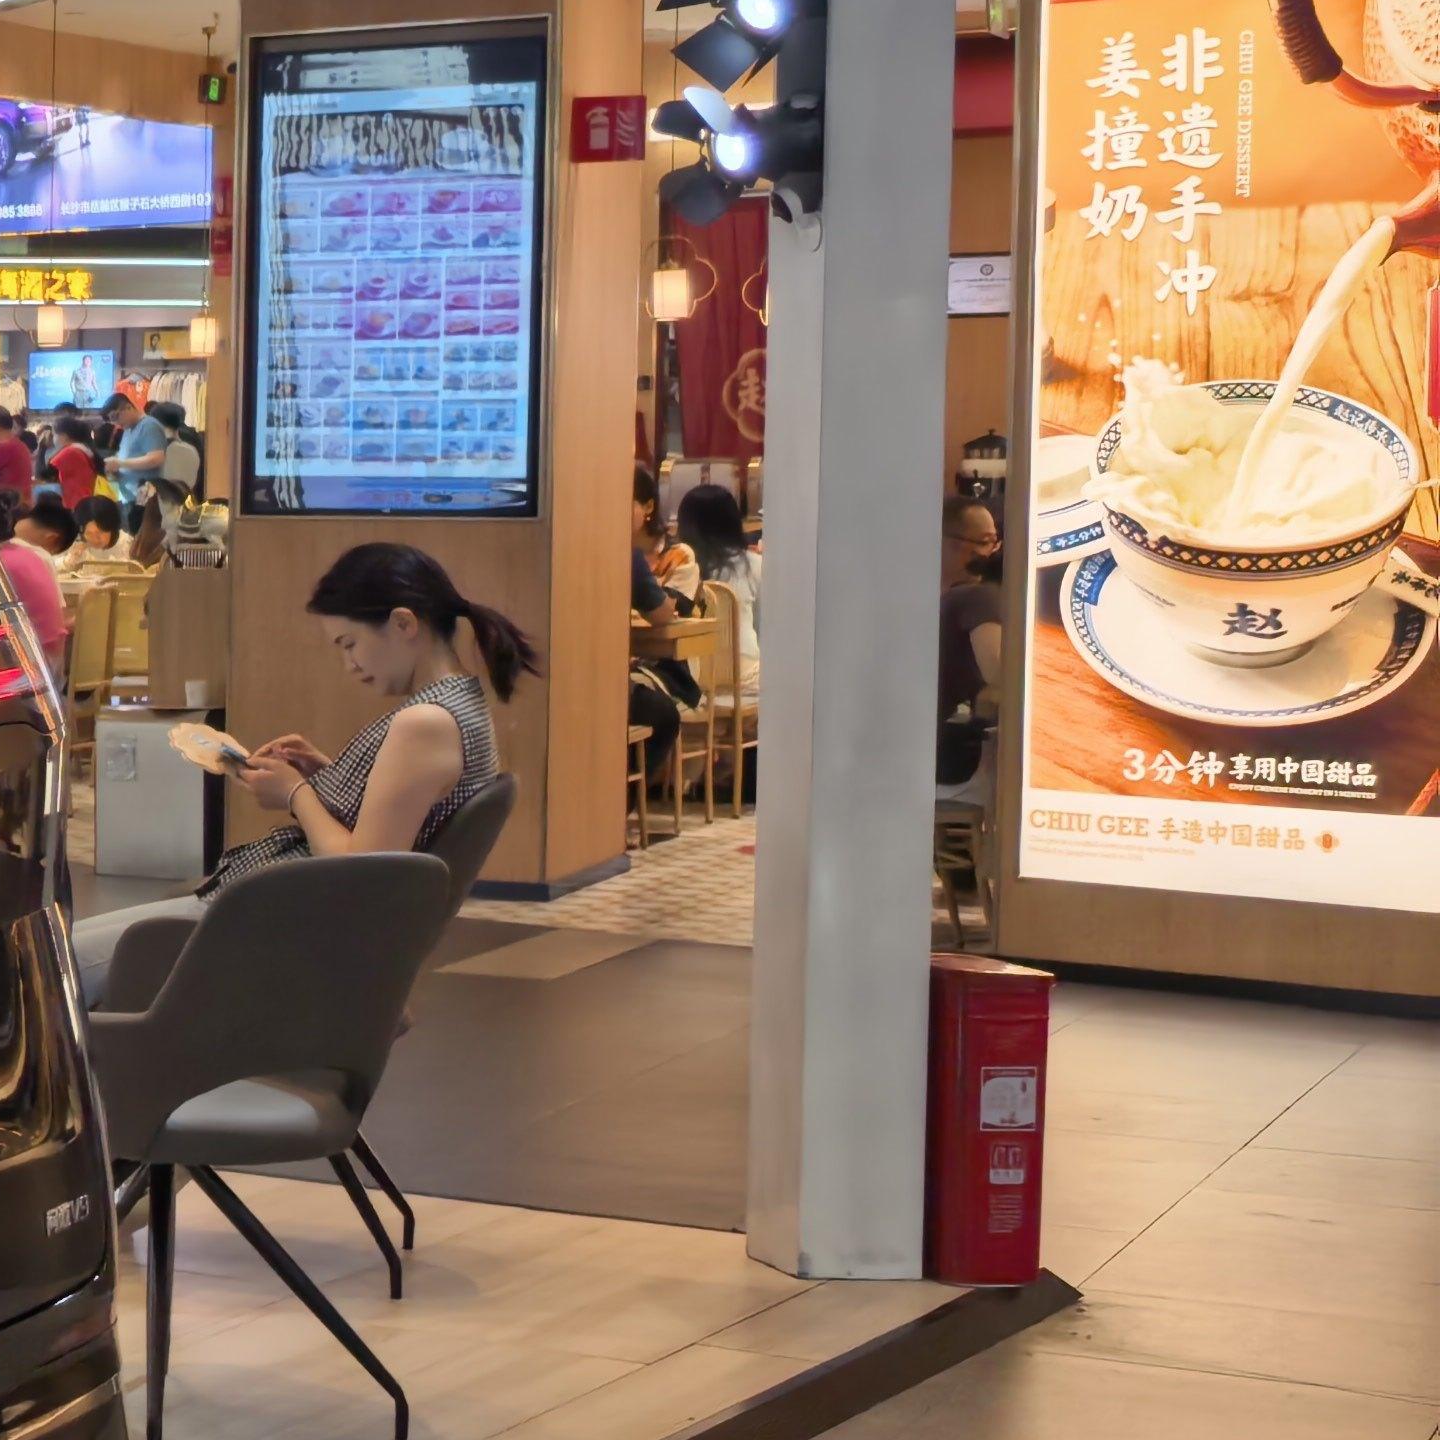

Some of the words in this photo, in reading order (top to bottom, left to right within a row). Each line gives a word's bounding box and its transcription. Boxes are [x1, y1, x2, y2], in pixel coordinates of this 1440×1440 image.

[1078, 30, 1152, 243] 姜撞奶
[1153, 26, 1225, 317] 非遗手冲
[1221, 602, 1288, 640] 赵
[1122, 748, 1225, 789] 3分钟
[1228, 752, 1378, 788] 享用中国甜品
[1028, 809, 1092, 833] CHIU
[1097, 815, 1150, 838] GEE
[1157, 817, 1306, 851] 手造中国甜品
